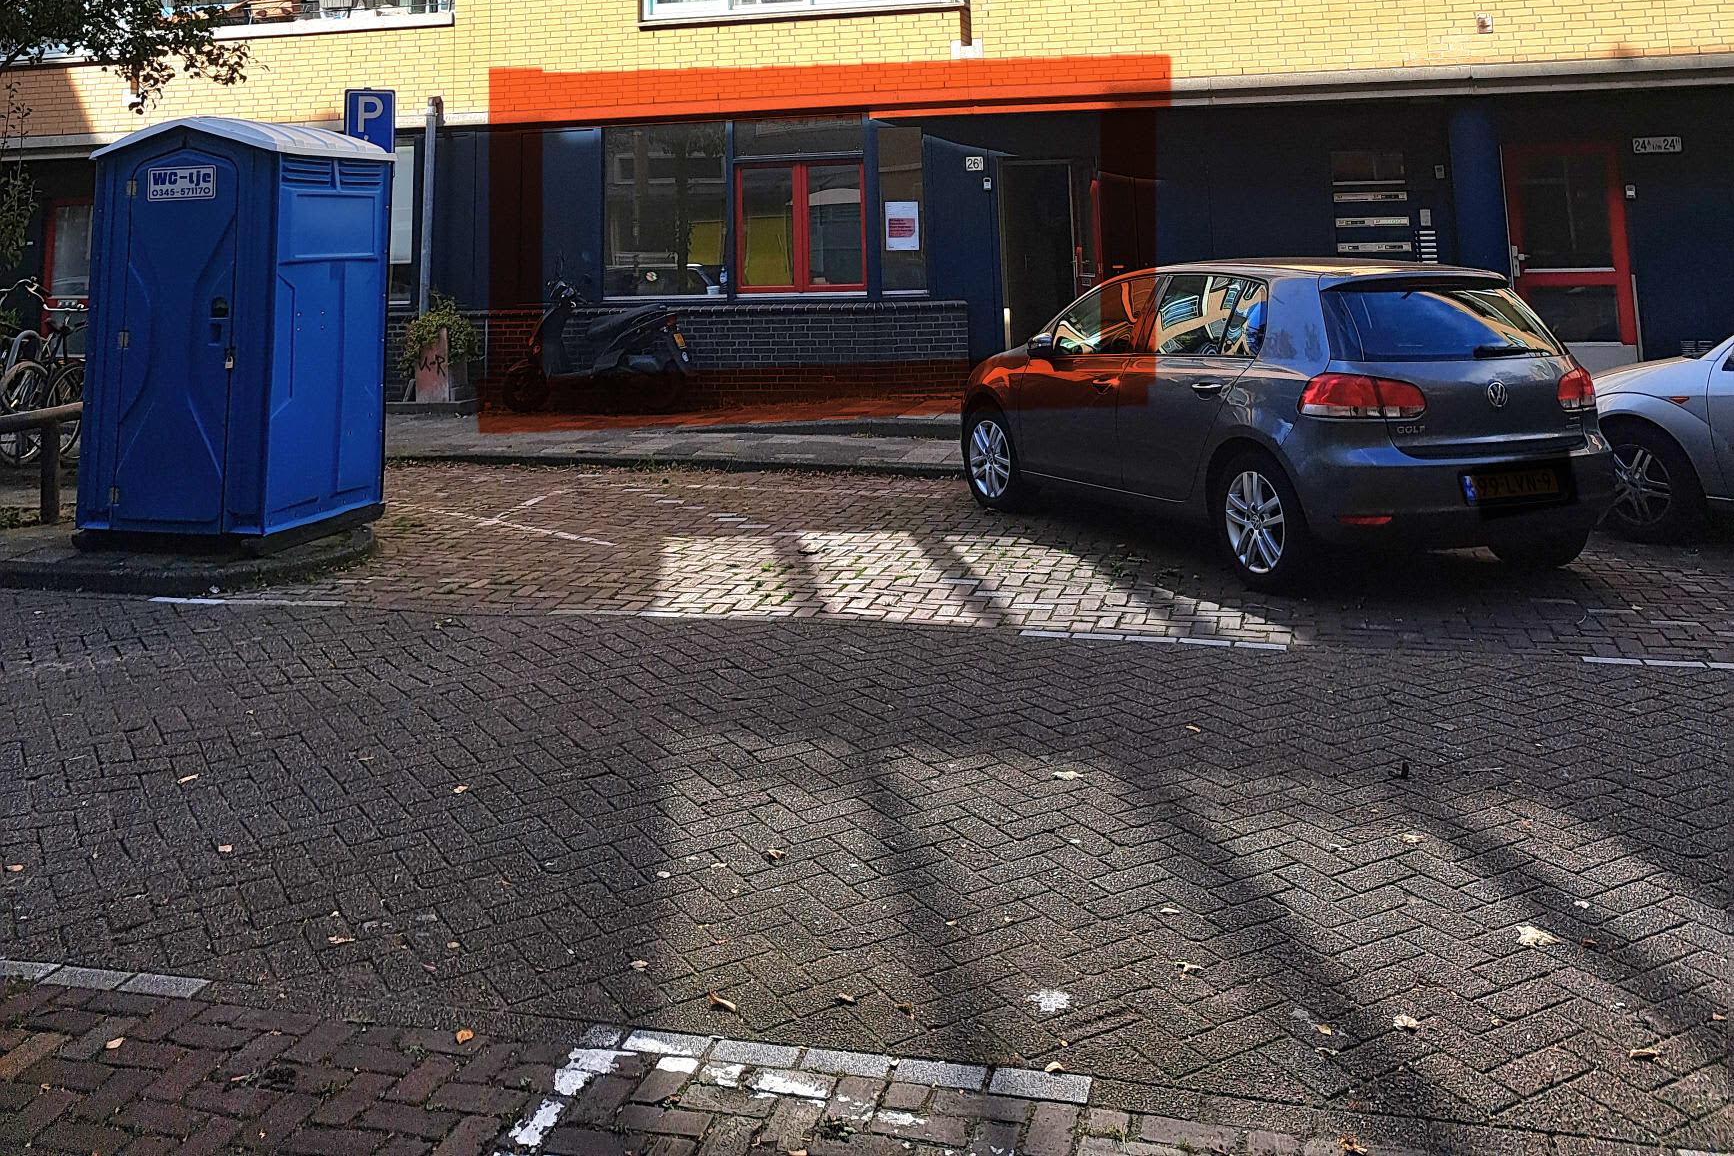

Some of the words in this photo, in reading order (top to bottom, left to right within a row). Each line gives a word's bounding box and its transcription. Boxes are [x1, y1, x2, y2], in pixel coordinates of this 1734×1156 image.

[357, 95, 384, 133] P
[151, 186, 211, 197] 0345-571170
[1397, 425, 1426, 435] GOLF
